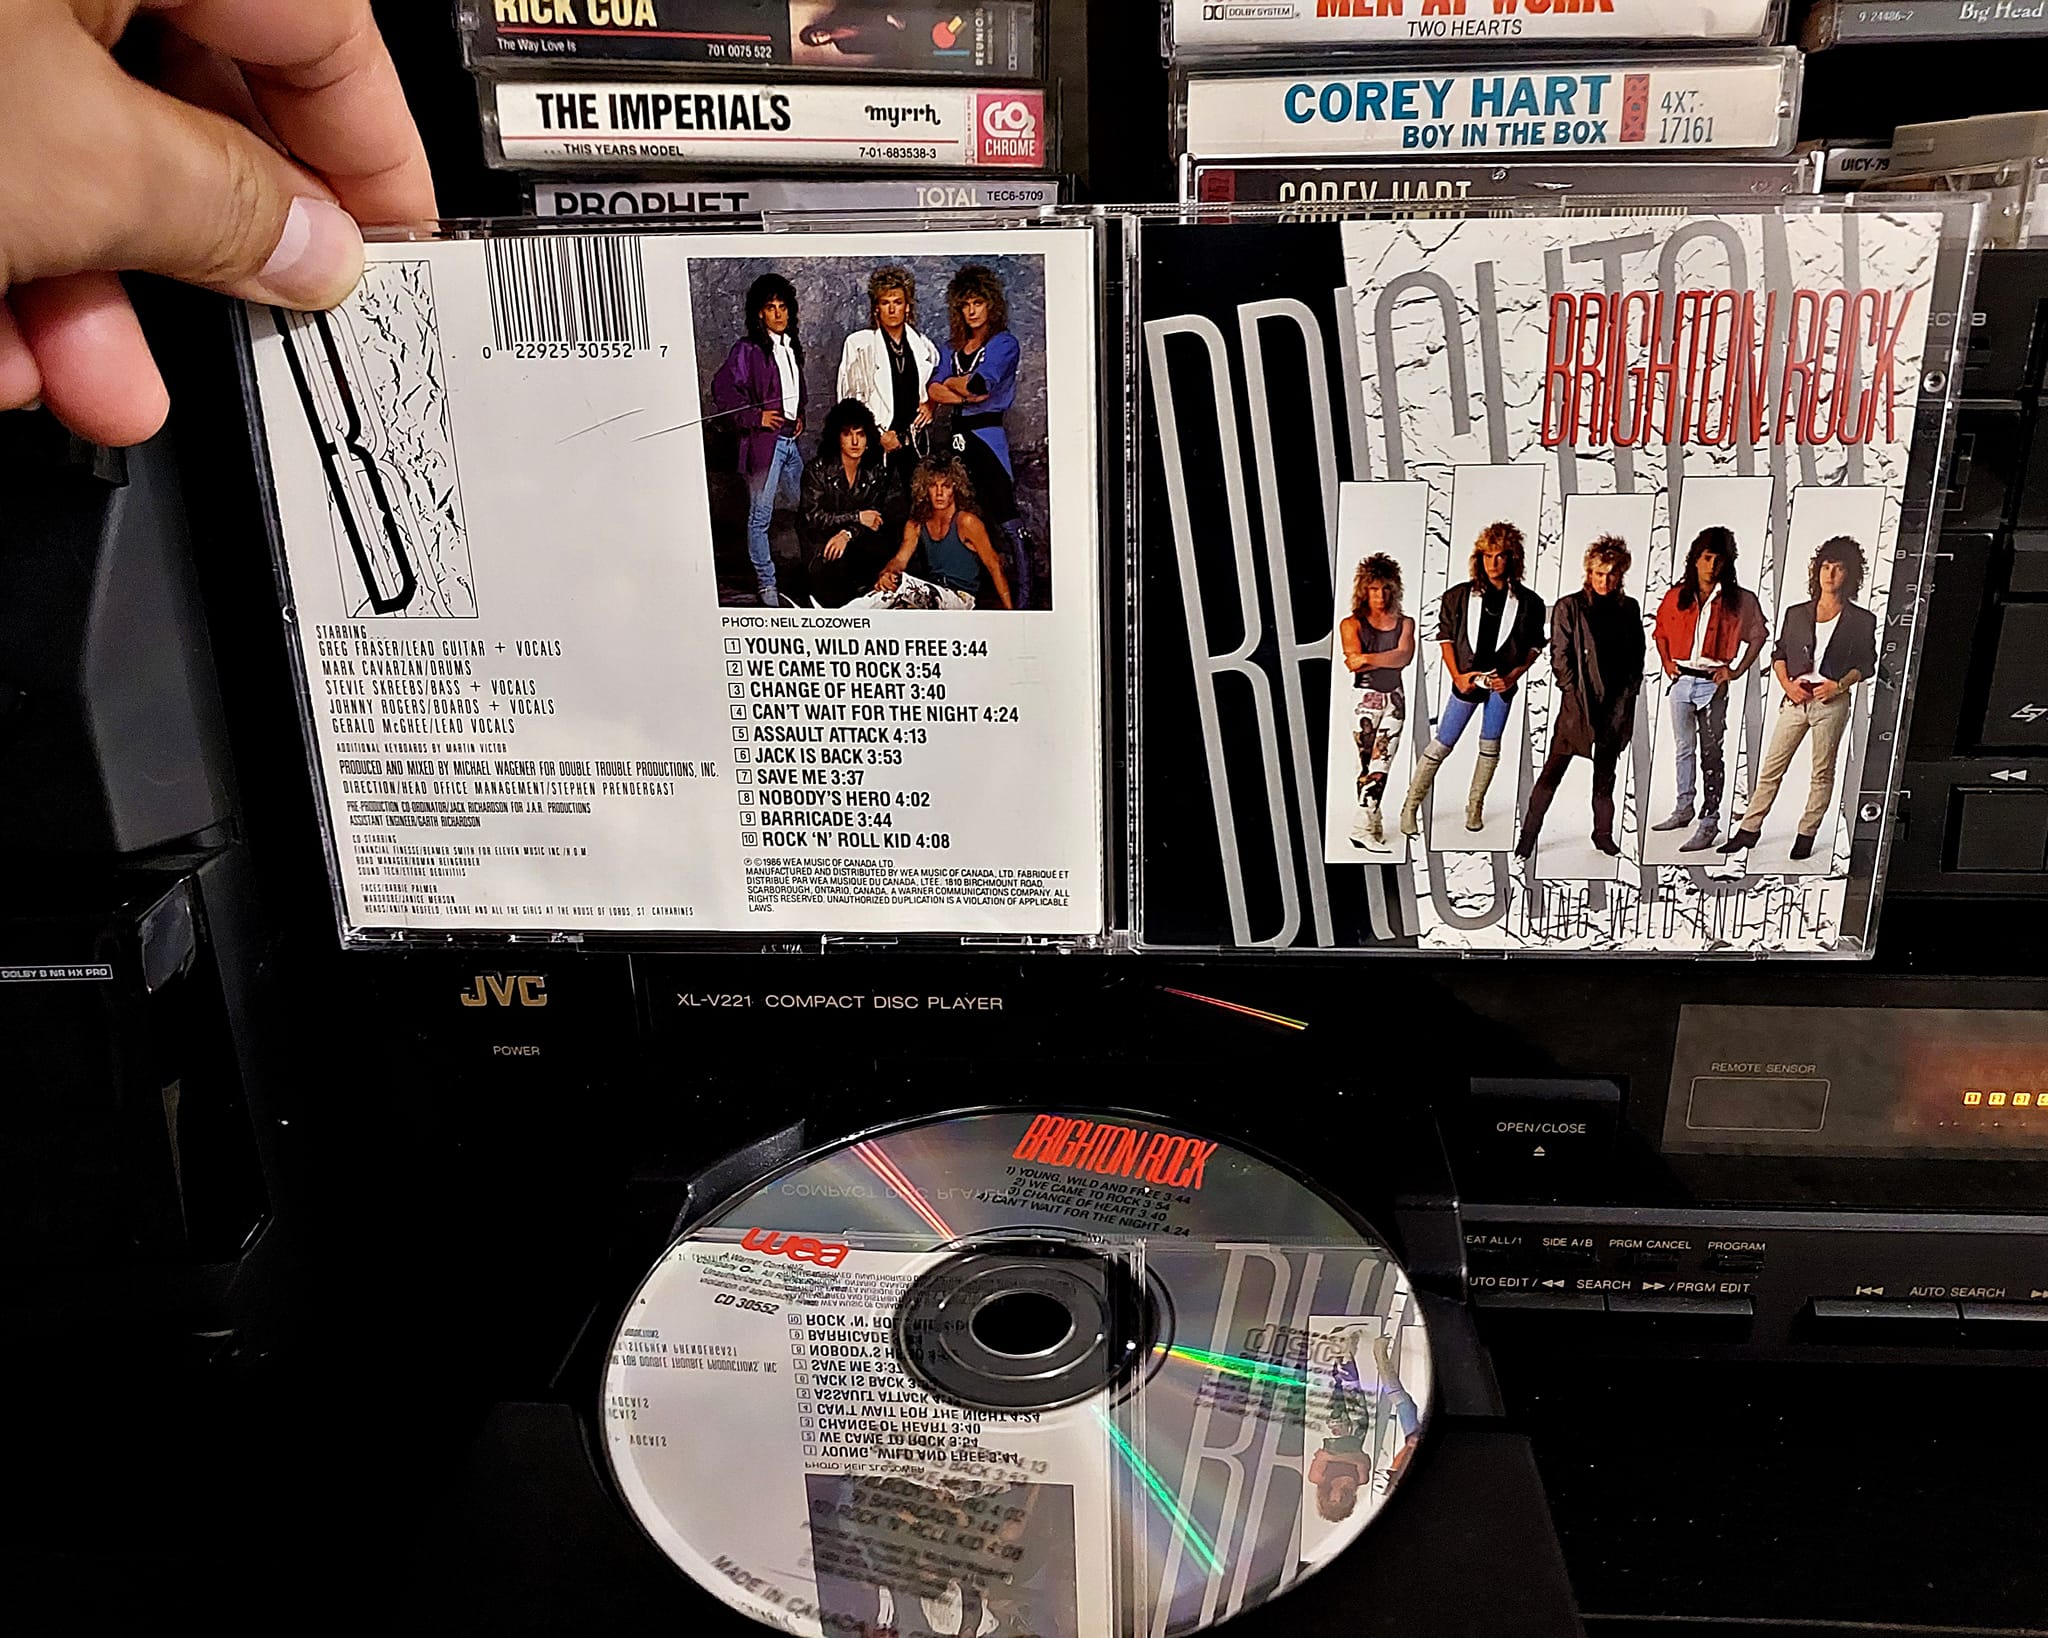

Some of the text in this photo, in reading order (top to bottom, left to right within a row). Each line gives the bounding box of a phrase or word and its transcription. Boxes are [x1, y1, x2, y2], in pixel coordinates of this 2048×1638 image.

[495, 0, 577, 24] RICK
[1228, 8, 1291, 17] DOLBY SYSTEM
[1958, 1, 1990, 22] Big
[1993, 0, 2044, 19] Head
[1406, 18, 1523, 37] TWO HEARTS
[497, 38, 577, 53] The Way Love Is
[707, 44, 772, 58] 701 0075 522
[1284, 78, 1455, 124] COREY
[1471, 74, 1613, 118] HART
[536, 93, 792, 131] THE IMPERIALS
[864, 104, 941, 128] myrrh
[1402, 119, 1608, 150] BOY IN THE BOX
[1659, 117, 1713, 143] 17161
[596, 145, 637, 156] YEARS
[640, 145, 684, 157] MODEL
[858, 147, 937, 159] 7-01-683538-3
[985, 139, 1036, 157] CHROME
[554, 188, 1044, 215] PROPHET TOTAL TEC6-5709
[482, 343, 668, 360] 0 22925 30552 7
[1541, 289, 1916, 447] BRIGHTON ROCK
[721, 617, 871, 629] PHOTO: NEIL ZLOZOWER
[318, 640, 349, 657] GREG
[354, 640, 435, 657] FRASER/LEAD
[442, 640, 486, 657] GUITAR
[516, 640, 562, 657] VOCALS
[744, 637, 988, 657] YOUNG, WILD AND FREE 3:44
[321, 660, 473, 677] MARK CAVARZAN/DRUMS
[747, 660, 942, 679] WE CAME TO ROCK 3:54
[325, 679, 366, 696] STEVIE
[372, 679, 462, 696] SKREEBS/BASS
[491, 680, 537, 696] VOCALS
[750, 682, 946, 700] CHANGE OF HEART 3:40
[329, 698, 373, 715] JOHNNY
[381, 699, 480, 715] ROGERS/BOARDS
[509, 699, 556, 715] VOCALS
[752, 703, 1019, 723] CAN'T WAIT FOR THE NIGHT 4:24
[332, 718, 376, 735] GERALD
[470, 718, 515, 734] VOCALS
[338, 759, 382, 775] PRODUCED
[385, 760, 404, 775] AND
[406, 760, 435, 775] MIXED
[437, 760, 449, 776] BY
[453, 760, 491, 776] MICHAEL
[494, 760, 536, 776] WAGENER
[539, 760, 556, 776] FOR
[559, 760, 591, 776] DOUBLE
[595, 761, 632, 777] TROUBLE
[758, 790, 931, 808] NOBODY'S HERO 4:02
[761, 811, 893, 828] BARRICADE 3:44
[762, 831, 808, 847] ROCK
[838, 832, 880, 848] ROLL
[884, 833, 912, 848] KID
[915, 833, 950, 849] 4:08
[898, 887, 934, 896] WARNER
[935, 888, 1009, 896] COMMUNICATIONS
[1054, 889, 1070, 897] ALL
[1503, 888, 1832, 941] YOUNG WILD AND FREE
[86, 968, 108, 976] PRO
[460, 975, 548, 1007] JVC
[676, 993, 1004, 1011] XL-V221 COMPACT DISC PLAYER
[493, 1046, 541, 1056] POWER
[1711, 1062, 1816, 1075] REMOTE SENSOR
[1496, 1121, 1587, 1135] OPEN/CLOSE
[1012, 1114, 1219, 1189] BRIGHTON ROCK
[741, 1227, 849, 1269] wea
[1542, 1237, 1593, 1248] SIDE A/B
[1608, 1239, 1692, 1250] PRGM CANCEL
[1708, 1241, 1766, 1251] PROGRAM
[1910, 1286, 2006, 1299] AUTO SEARCH
[714, 1293, 780, 1316] CD 30552
